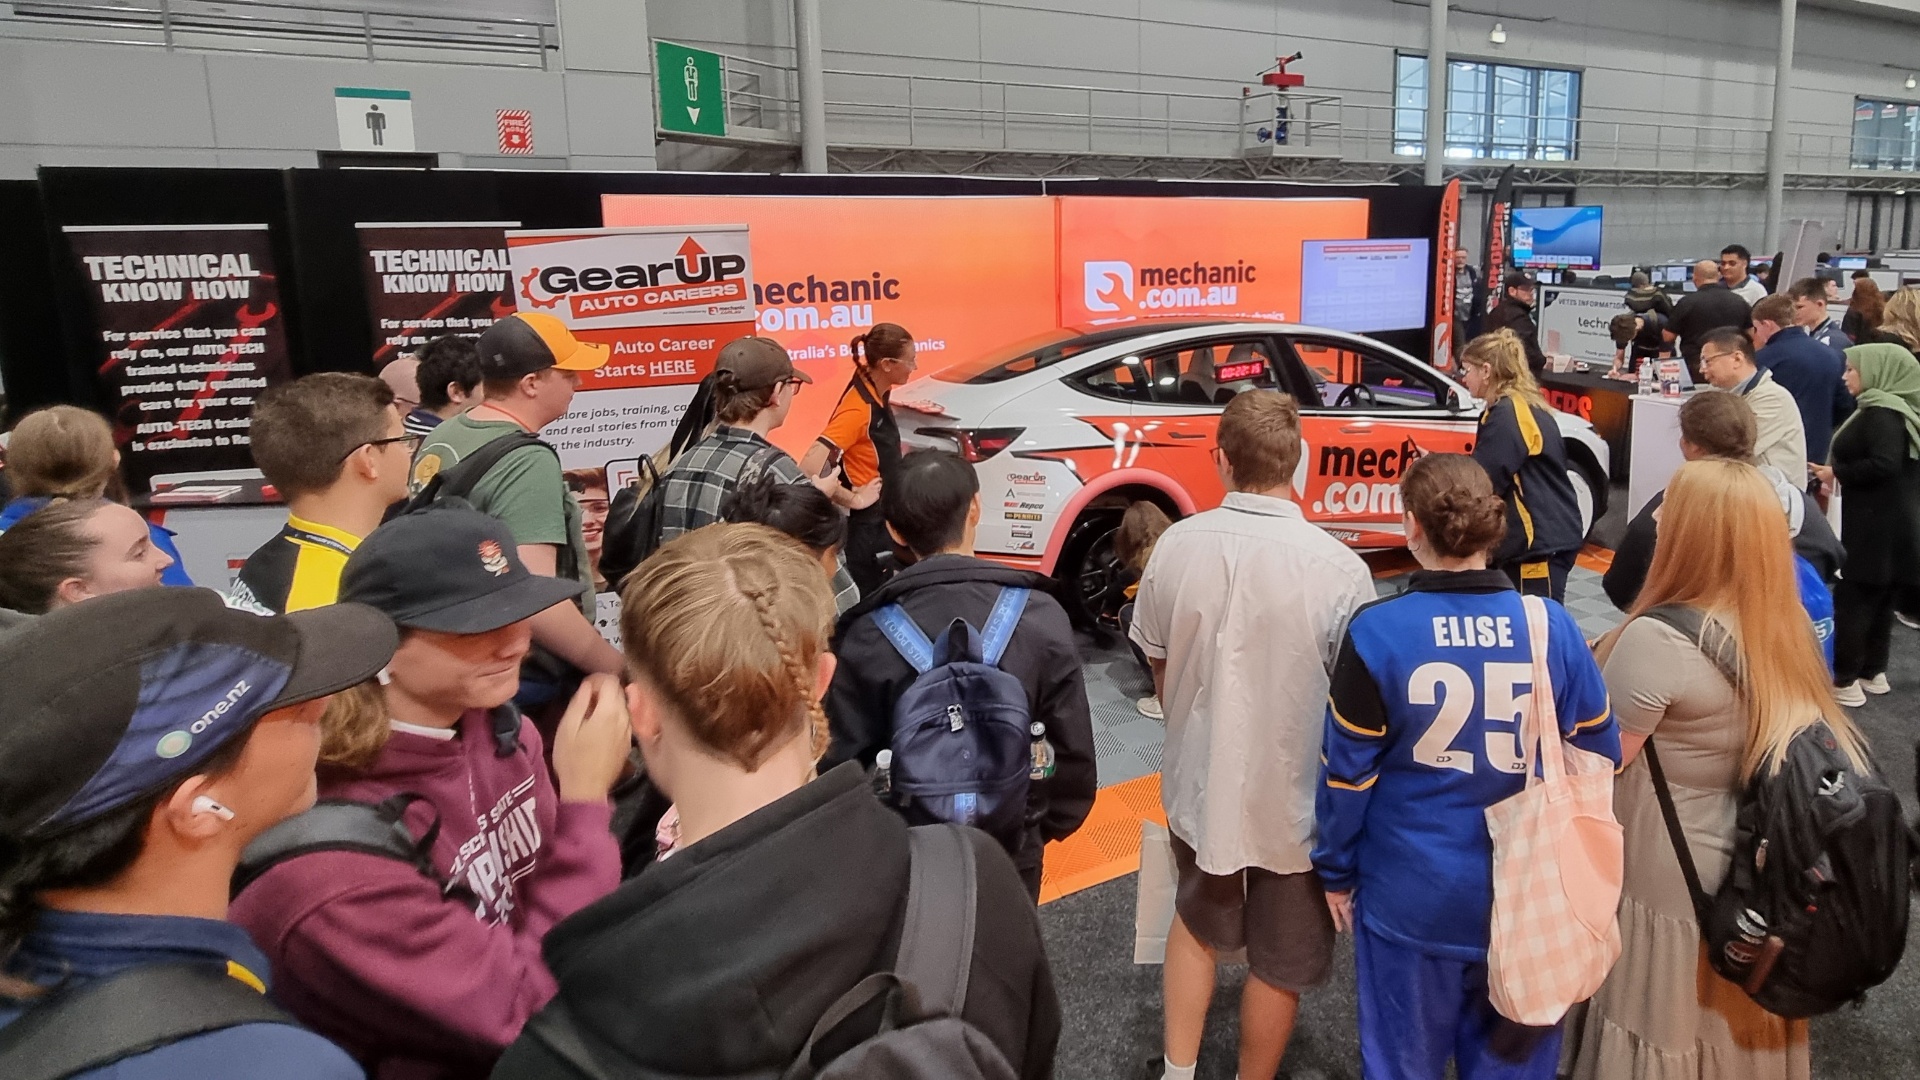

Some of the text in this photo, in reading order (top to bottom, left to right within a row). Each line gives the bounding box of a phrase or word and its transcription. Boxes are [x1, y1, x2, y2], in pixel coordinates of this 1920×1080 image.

[83, 253, 260, 281] TECHNICAL
[370, 248, 511, 273] TECHNICAL
[539, 253, 746, 294] GearUP
[1140, 259, 1257, 286] mechanic
[101, 280, 250, 303] KNOW HOW
[382, 272, 506, 294] KNOW HOW
[579, 282, 739, 312] AUTO CAREERS
[1139, 285, 1237, 310] .com.au
[381, 318, 400, 329] For
[402, 318, 444, 329] service
[446, 316, 469, 328] that
[470, 317, 492, 329] you
[755, 304, 873, 331] om.au
[103, 327, 266, 342] For service that you can
[386, 335, 409, 347] rely
[110, 342, 265, 361] rely on, our AUTO-TECH
[614, 336, 715, 355] Auto Career
[914, 338, 945, 353] anics
[125, 363, 177, 377] trained
[594, 358, 695, 379] Starts HERE
[120, 377, 267, 397] provide fully qualified
[139, 400, 172, 411] care
[174, 398, 194, 409] for
[198, 397, 228, 409] your
[556, 411, 588, 422] lore
[590, 407, 619, 420] jobs,
[622, 404, 670, 417] training,
[136, 418, 213, 434] AUTO-TECH
[545, 425, 569, 436] and
[571, 423, 595, 434] real
[597, 419, 638, 432] stories
[640, 419, 668, 429] from
[215, 435, 230, 446] to
[561, 440, 581, 450] the
[583, 436, 635, 451] industry.
[1319, 440, 1421, 479] mech
[1019, 502, 1045, 510] Repco
[1312, 482, 1405, 514] .com
[1432, 616, 1514, 648] ELISE
[191, 679, 252, 736] one.nz
[1408, 661, 1533, 774] 25
